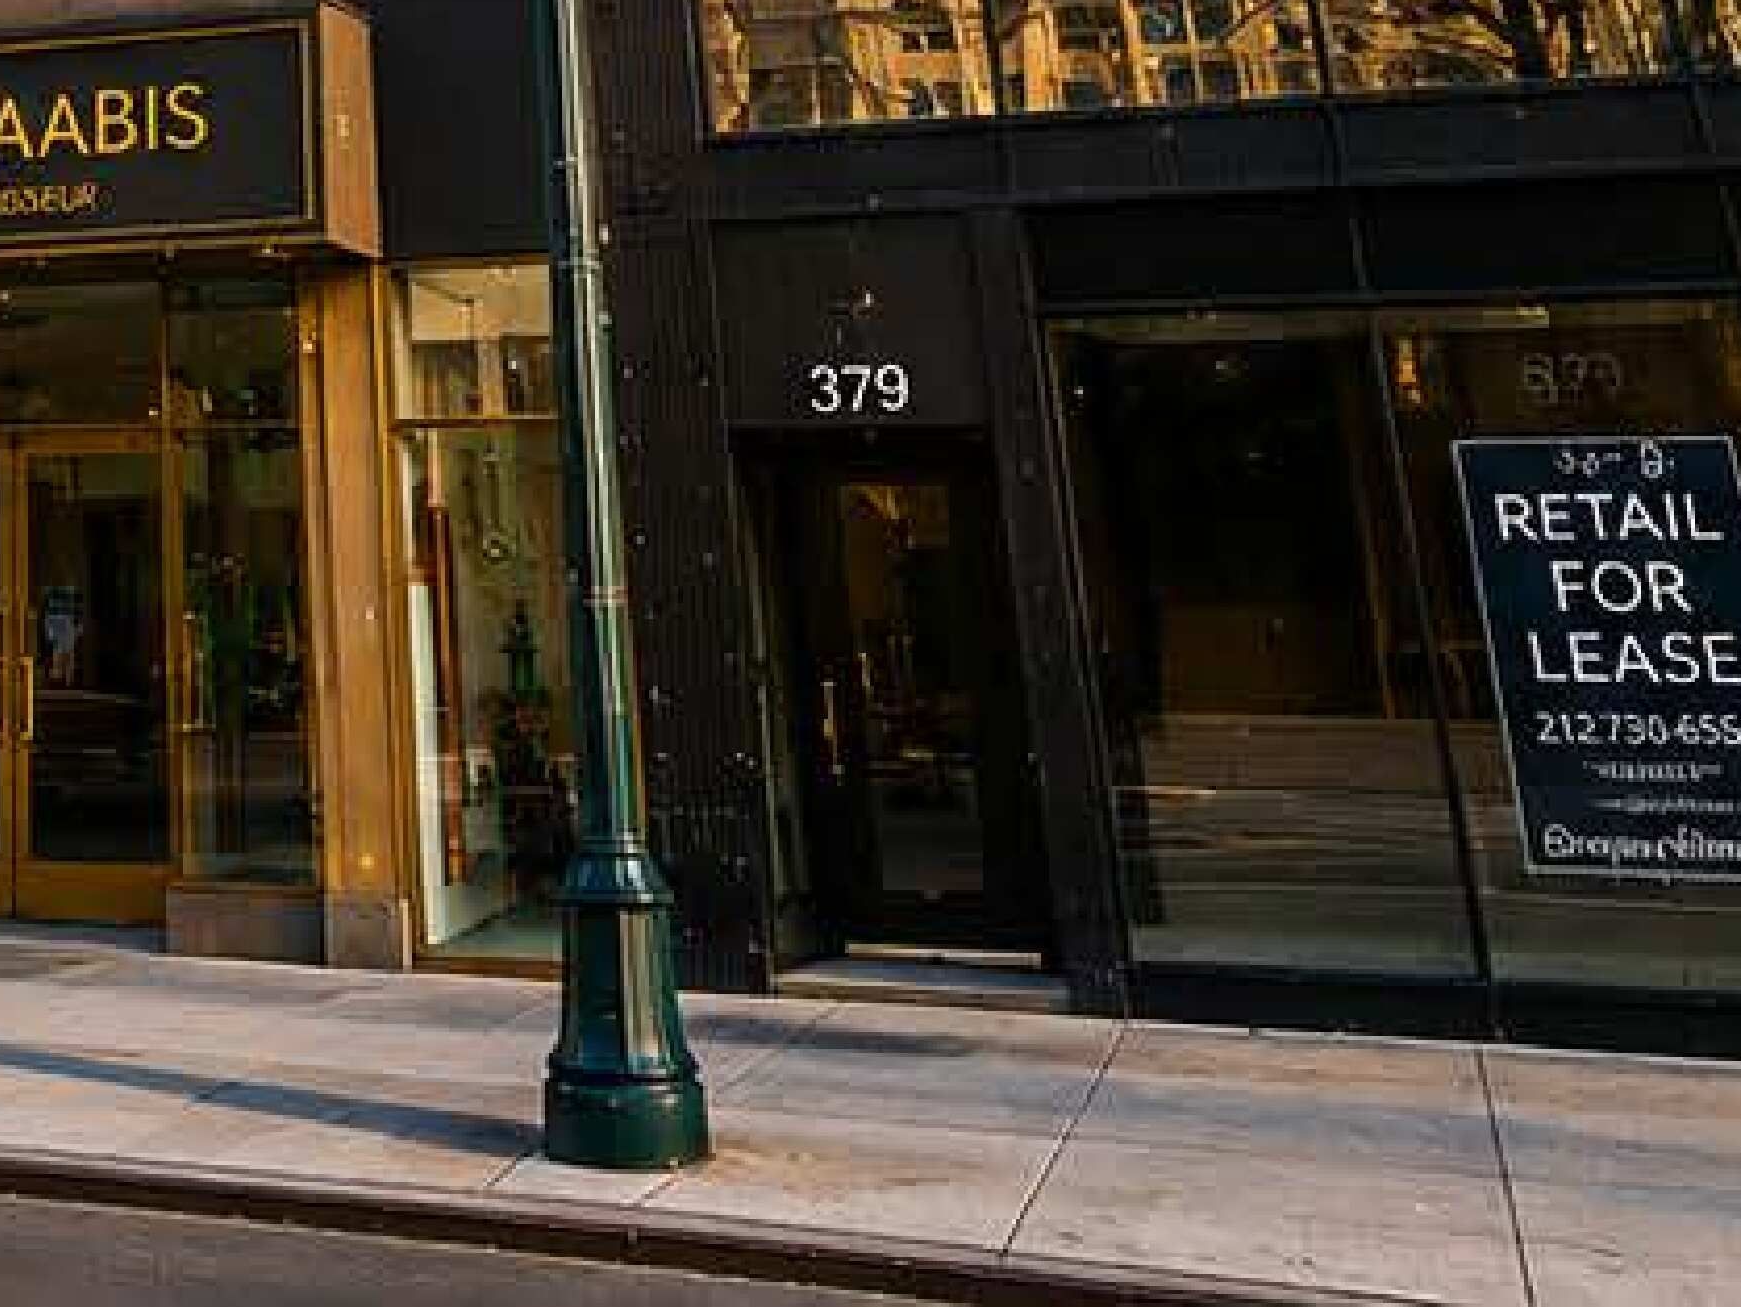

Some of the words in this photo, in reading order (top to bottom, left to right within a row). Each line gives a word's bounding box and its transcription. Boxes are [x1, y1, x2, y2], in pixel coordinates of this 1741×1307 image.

[810, 363, 909, 412] 379
[1494, 492, 1725, 542] RETAIL
[1548, 560, 1693, 613] FOR
